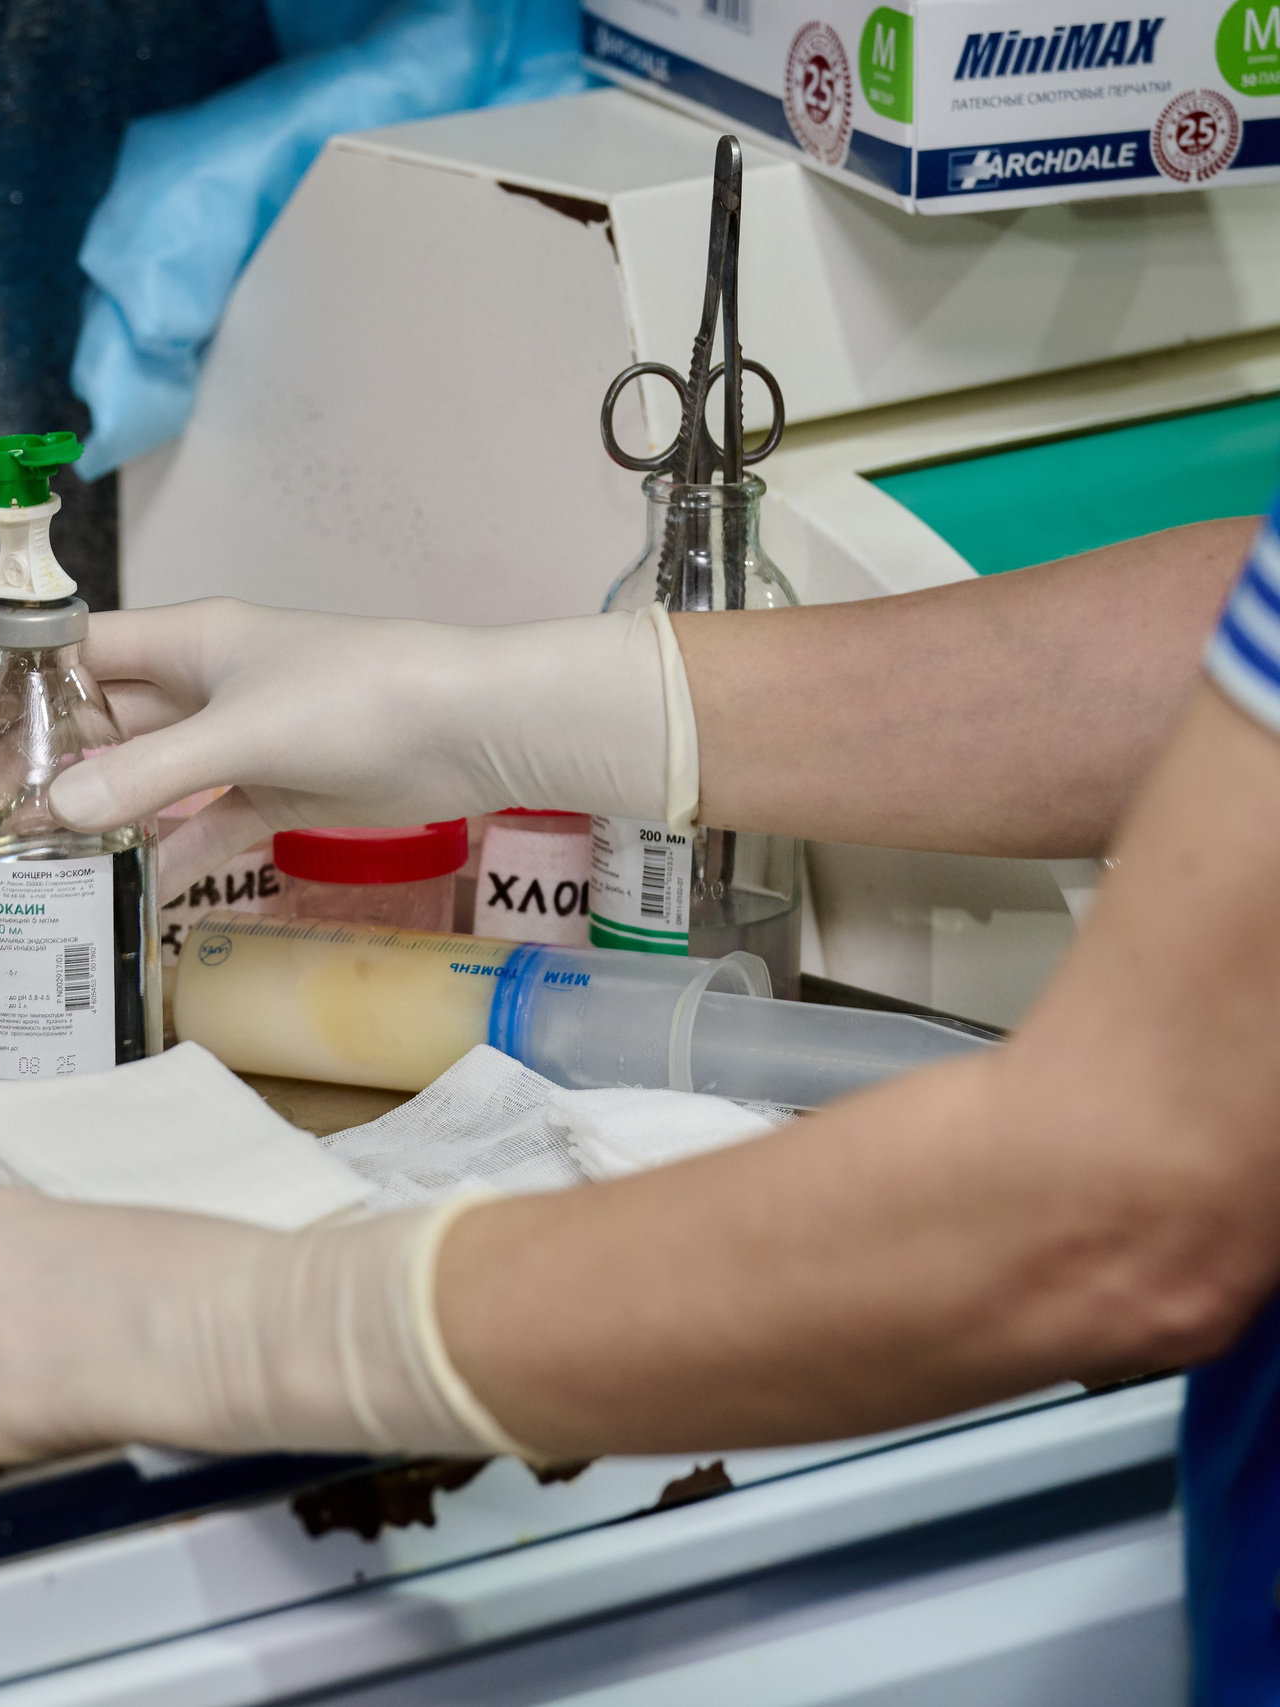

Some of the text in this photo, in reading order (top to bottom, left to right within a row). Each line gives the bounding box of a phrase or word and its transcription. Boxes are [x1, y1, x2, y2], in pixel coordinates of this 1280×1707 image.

[871, 22, 897, 73] M
[953, 17, 1166, 81] MiniMAX
[803, 62, 835, 112] 25
[951, 79, 1172, 111] ЛАТЕКСНЫЕ СМОТРОВЫЕ ПЕРЧАТКИ
[1178, 116, 1215, 147] 25
[985, 142, 1138, 180] ARCHDALE
[639, 828, 662, 842] 200
[12, 868, 96, 880] КОНЦЕРН «ЭСКОМ»
[9, 927, 23, 935] мл
[27, 936, 79, 945] ЭНДОТОКСИНОВ
[449, 962, 518, 979] ТЮМЕНЬ
[543, 970, 591, 986] МИМ
[18, 1056, 40, 1074] 08
[56, 1054, 77, 1075] 25
